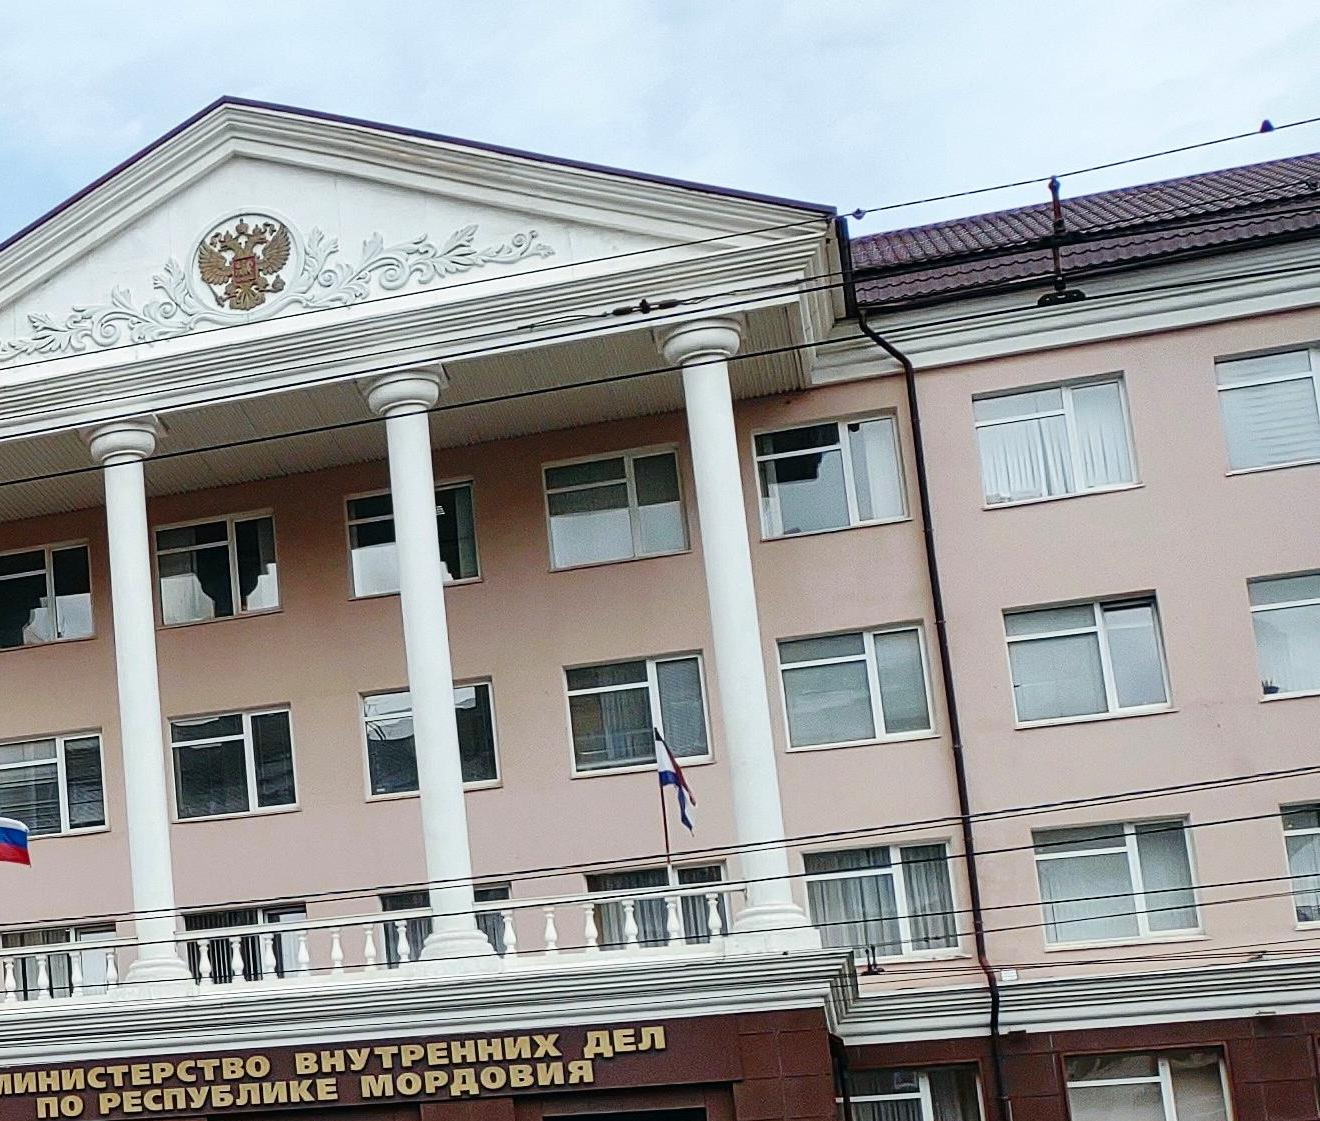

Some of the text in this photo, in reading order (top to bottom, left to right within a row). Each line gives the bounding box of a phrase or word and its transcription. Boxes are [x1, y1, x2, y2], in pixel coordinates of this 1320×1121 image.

[295, 1033, 562, 1075] ВНУТРЕННИХ
[583, 1026, 666, 1059] ДЕЛ
[36, 1060, 595, 1120] ПО РЕСПУБЛИКЕ МОРДОВИЯ
